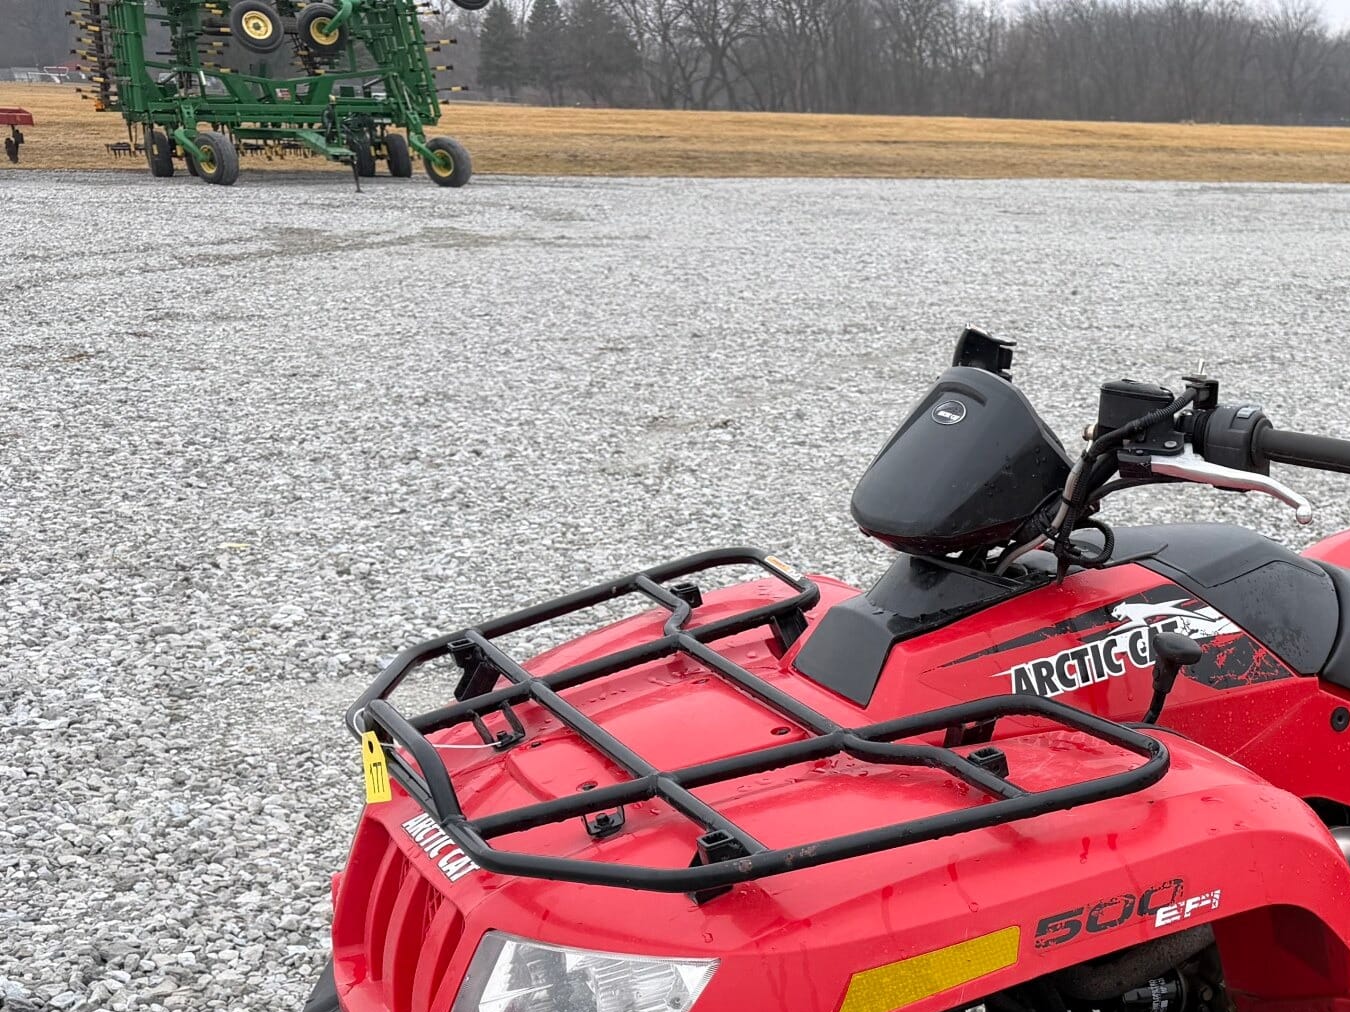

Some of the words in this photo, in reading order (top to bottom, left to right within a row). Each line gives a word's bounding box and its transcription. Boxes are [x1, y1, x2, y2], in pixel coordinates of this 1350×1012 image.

[1012, 637, 1124, 697] ARCTIC
[401, 812, 456, 860] ARCTIC
[437, 847, 481, 882] CAT
[1034, 878, 1184, 949] 500
